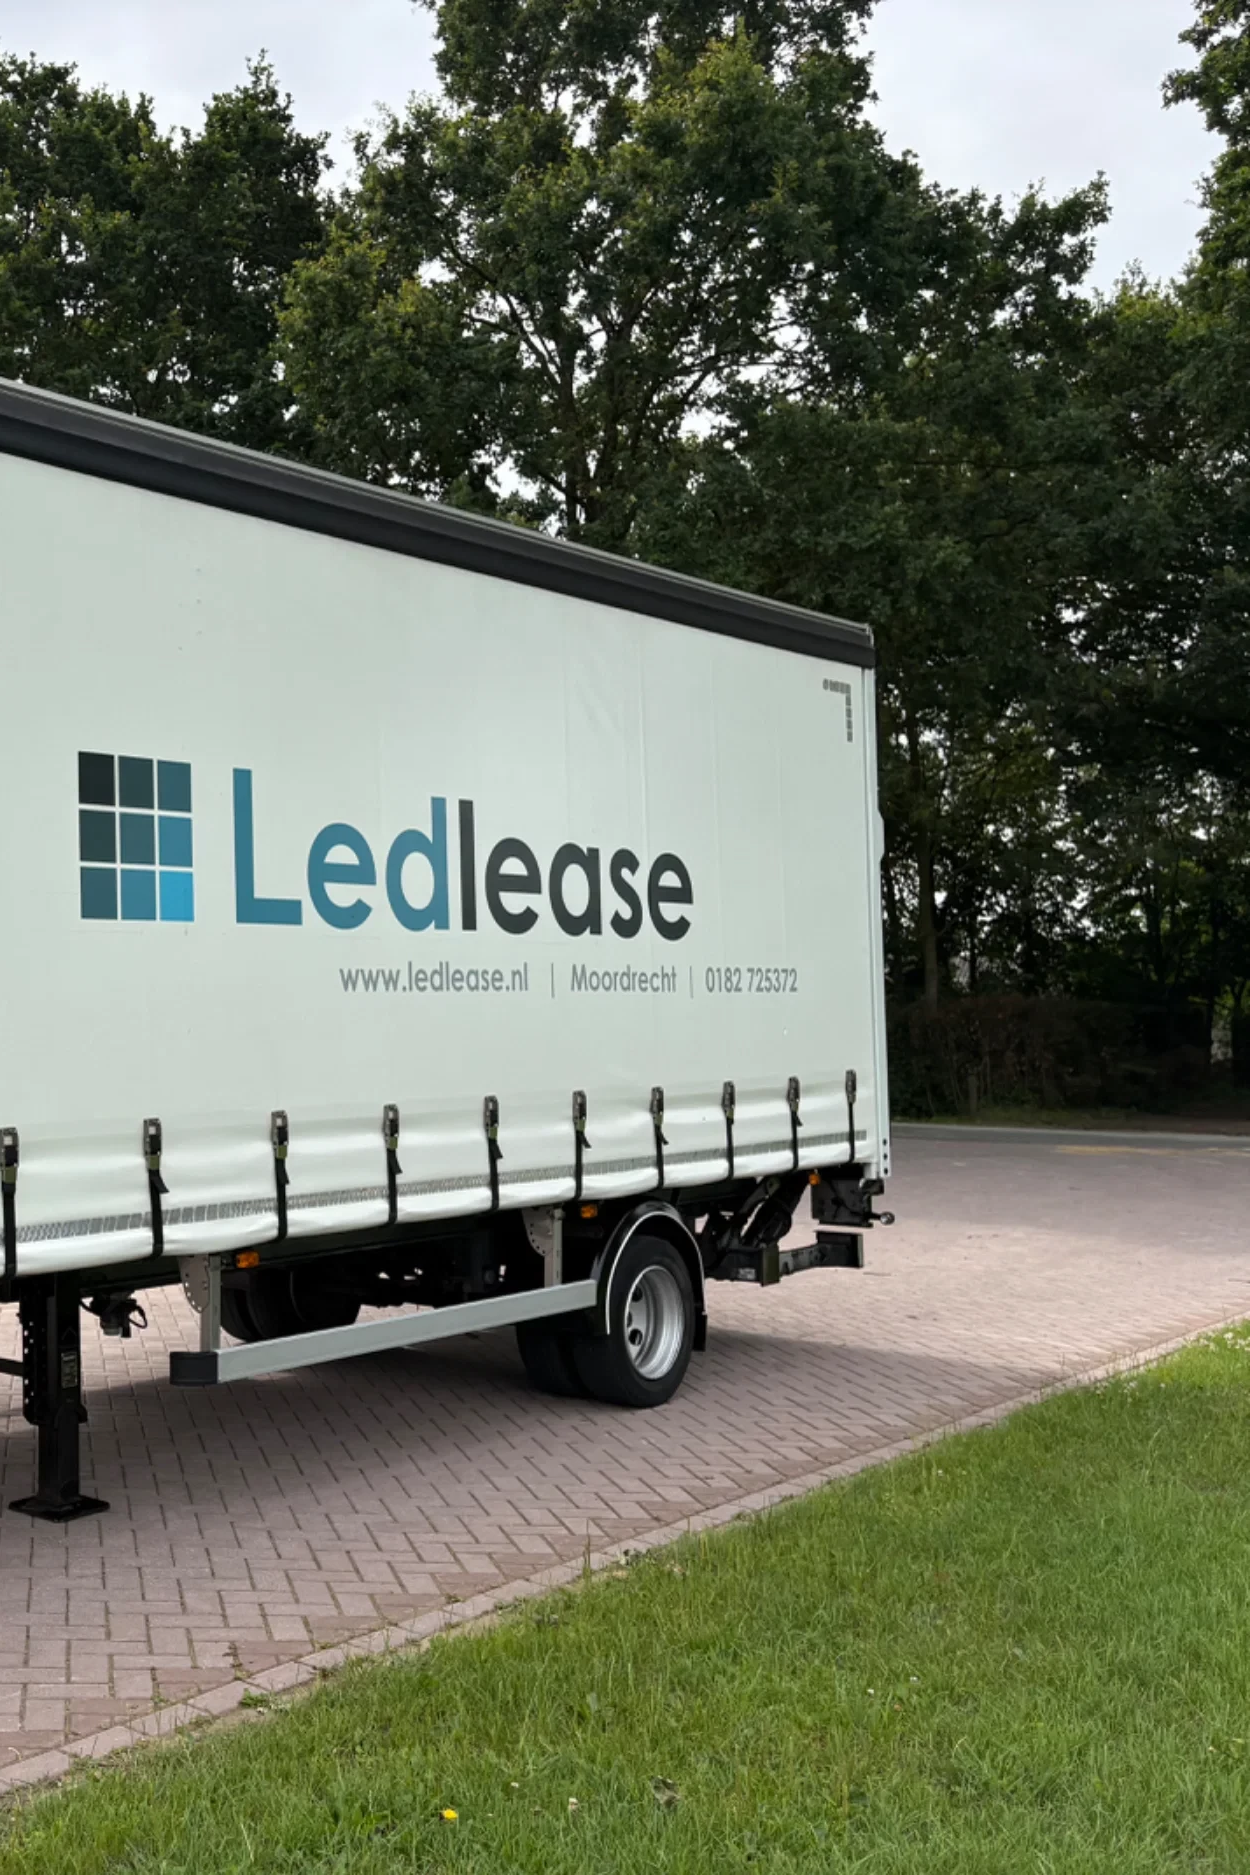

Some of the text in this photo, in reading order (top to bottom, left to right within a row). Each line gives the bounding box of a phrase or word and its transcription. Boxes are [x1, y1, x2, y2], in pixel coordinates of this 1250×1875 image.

[232, 767, 695, 942] Ledlease
[338, 960, 798, 994] www.ledlease.nl Moordrecht 0182 725372
